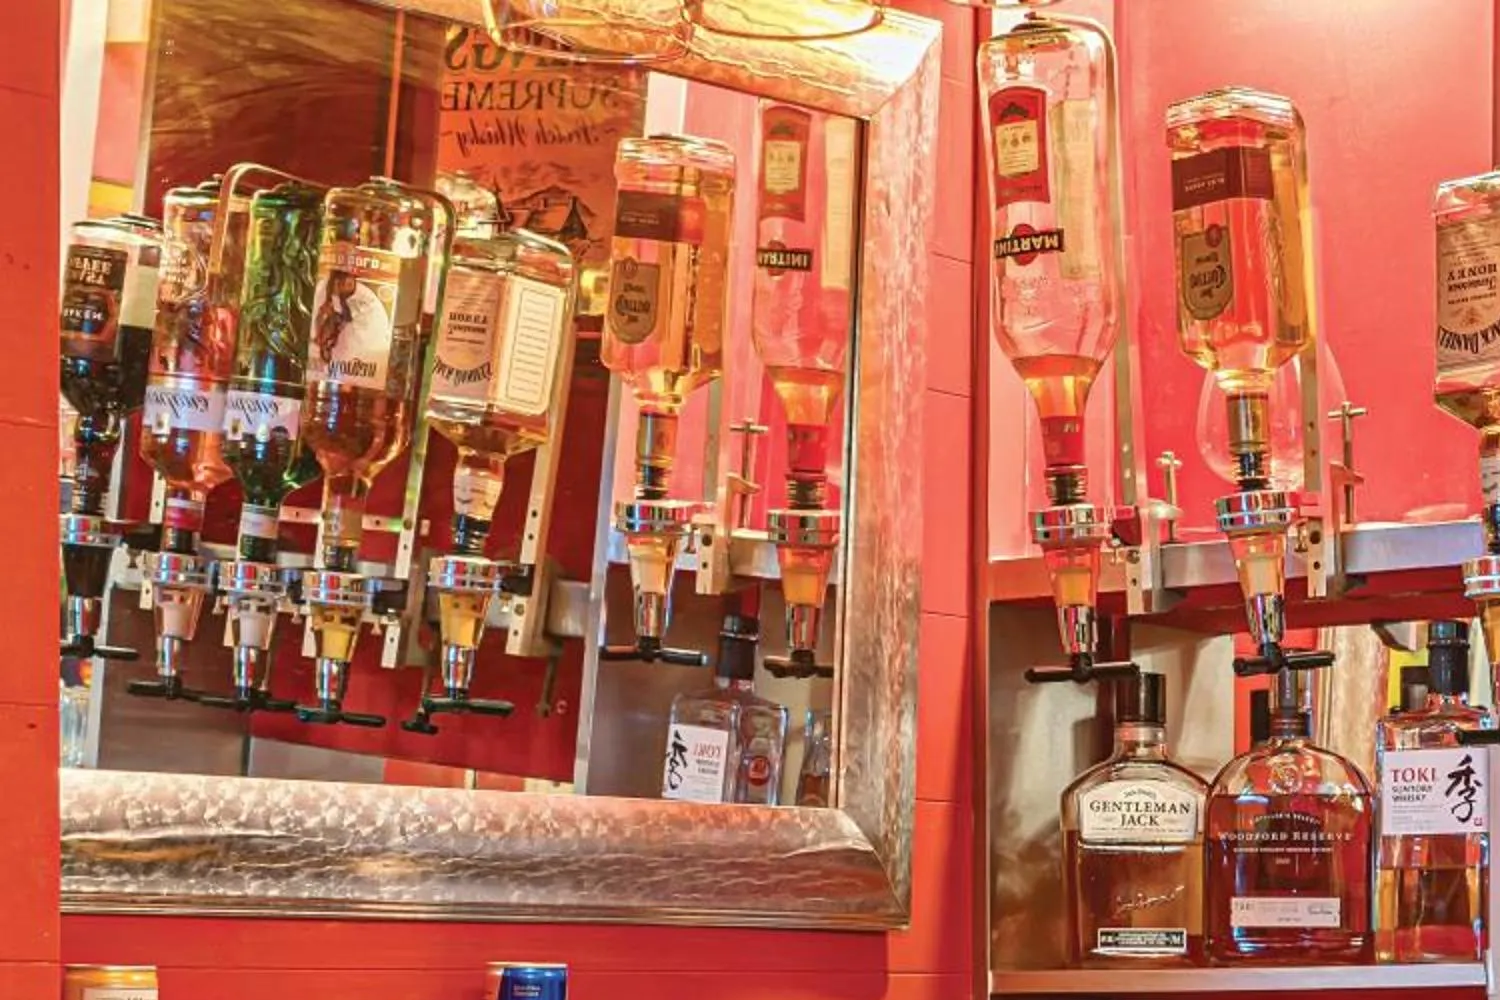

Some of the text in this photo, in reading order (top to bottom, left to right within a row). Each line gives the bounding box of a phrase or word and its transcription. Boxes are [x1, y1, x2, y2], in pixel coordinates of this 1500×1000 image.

[1447, 263, 1497, 281] HONEY
[1438, 325, 1479, 354] DANIEL
[1391, 767, 1436, 783] TOKI
[1089, 800, 1191, 814] GENTLEMAN
[1120, 815, 1160, 827] JACK
[1218, 830, 1352, 841] WOODFORD RESERVE
